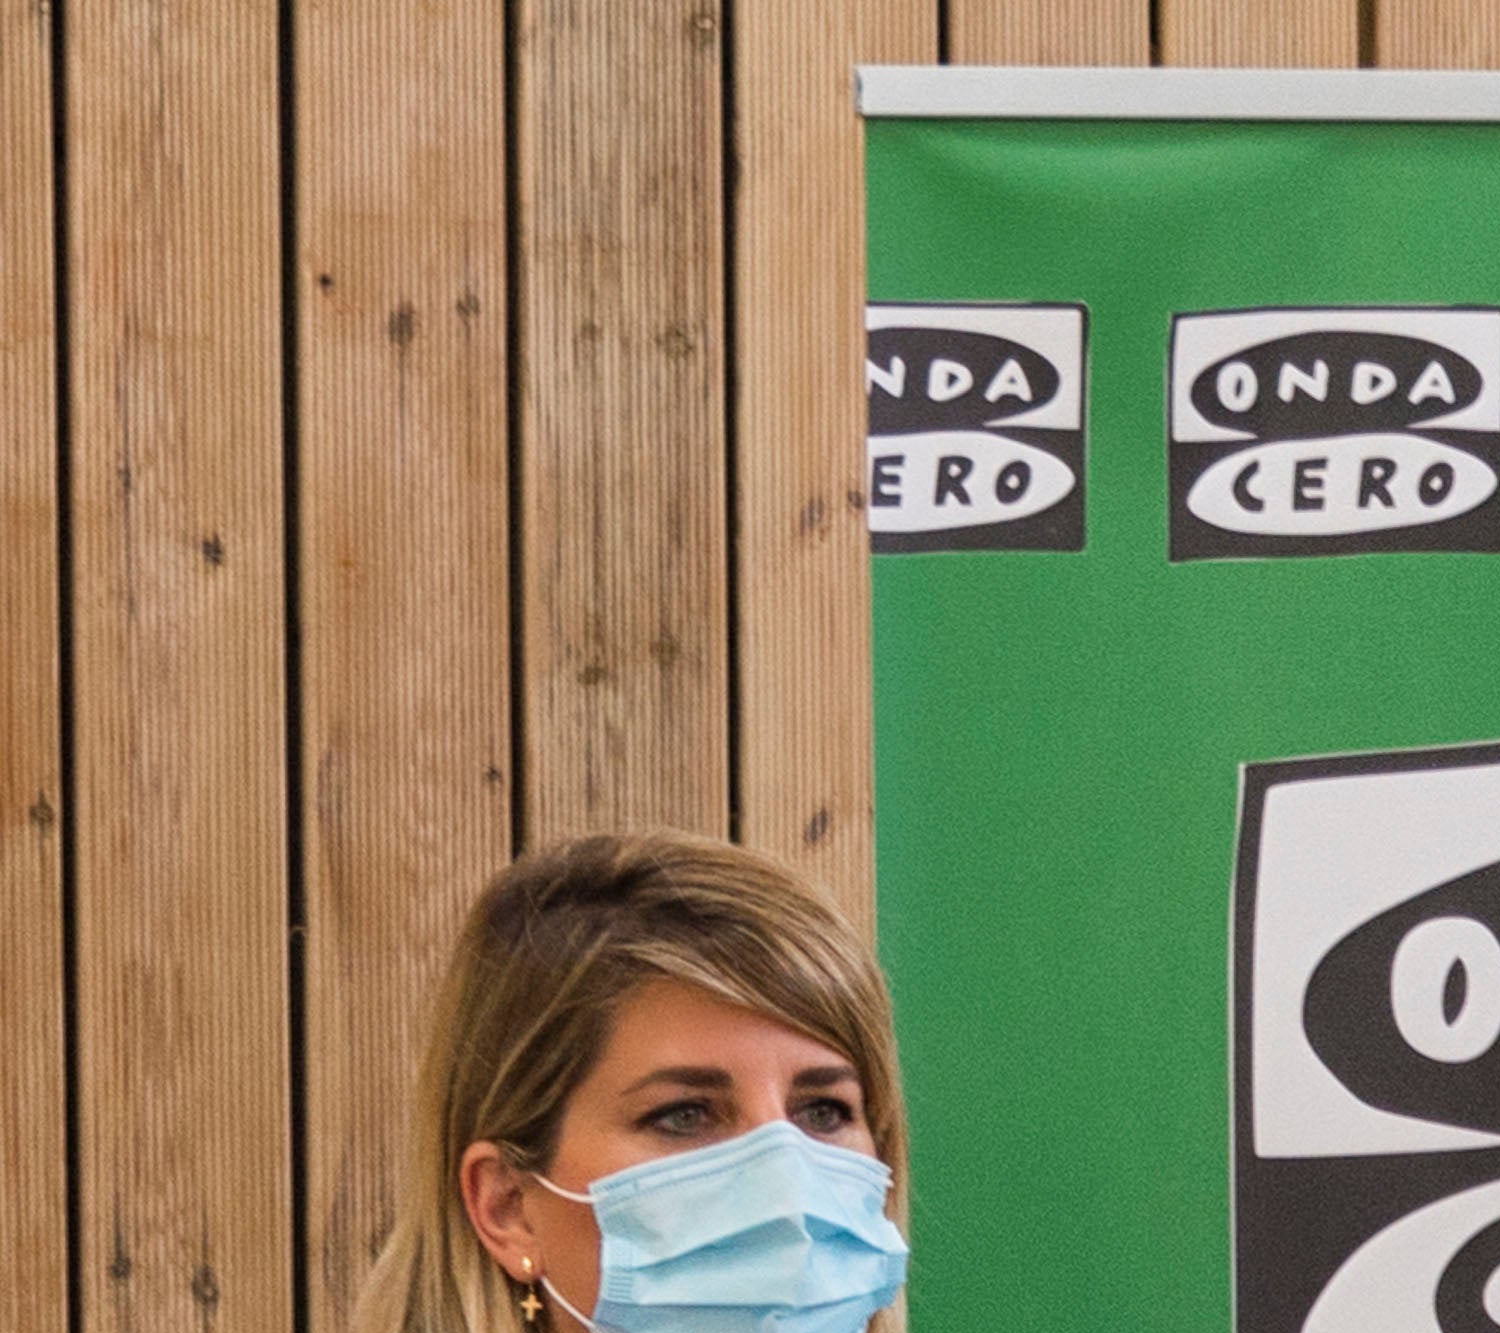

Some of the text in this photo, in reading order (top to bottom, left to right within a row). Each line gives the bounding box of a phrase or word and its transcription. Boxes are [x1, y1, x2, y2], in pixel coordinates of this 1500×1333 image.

[866, 356, 1033, 402] NDA
[1216, 359, 1455, 412] ONDA
[870, 454, 1032, 508] ERO
[1234, 459, 1452, 510] CERO
